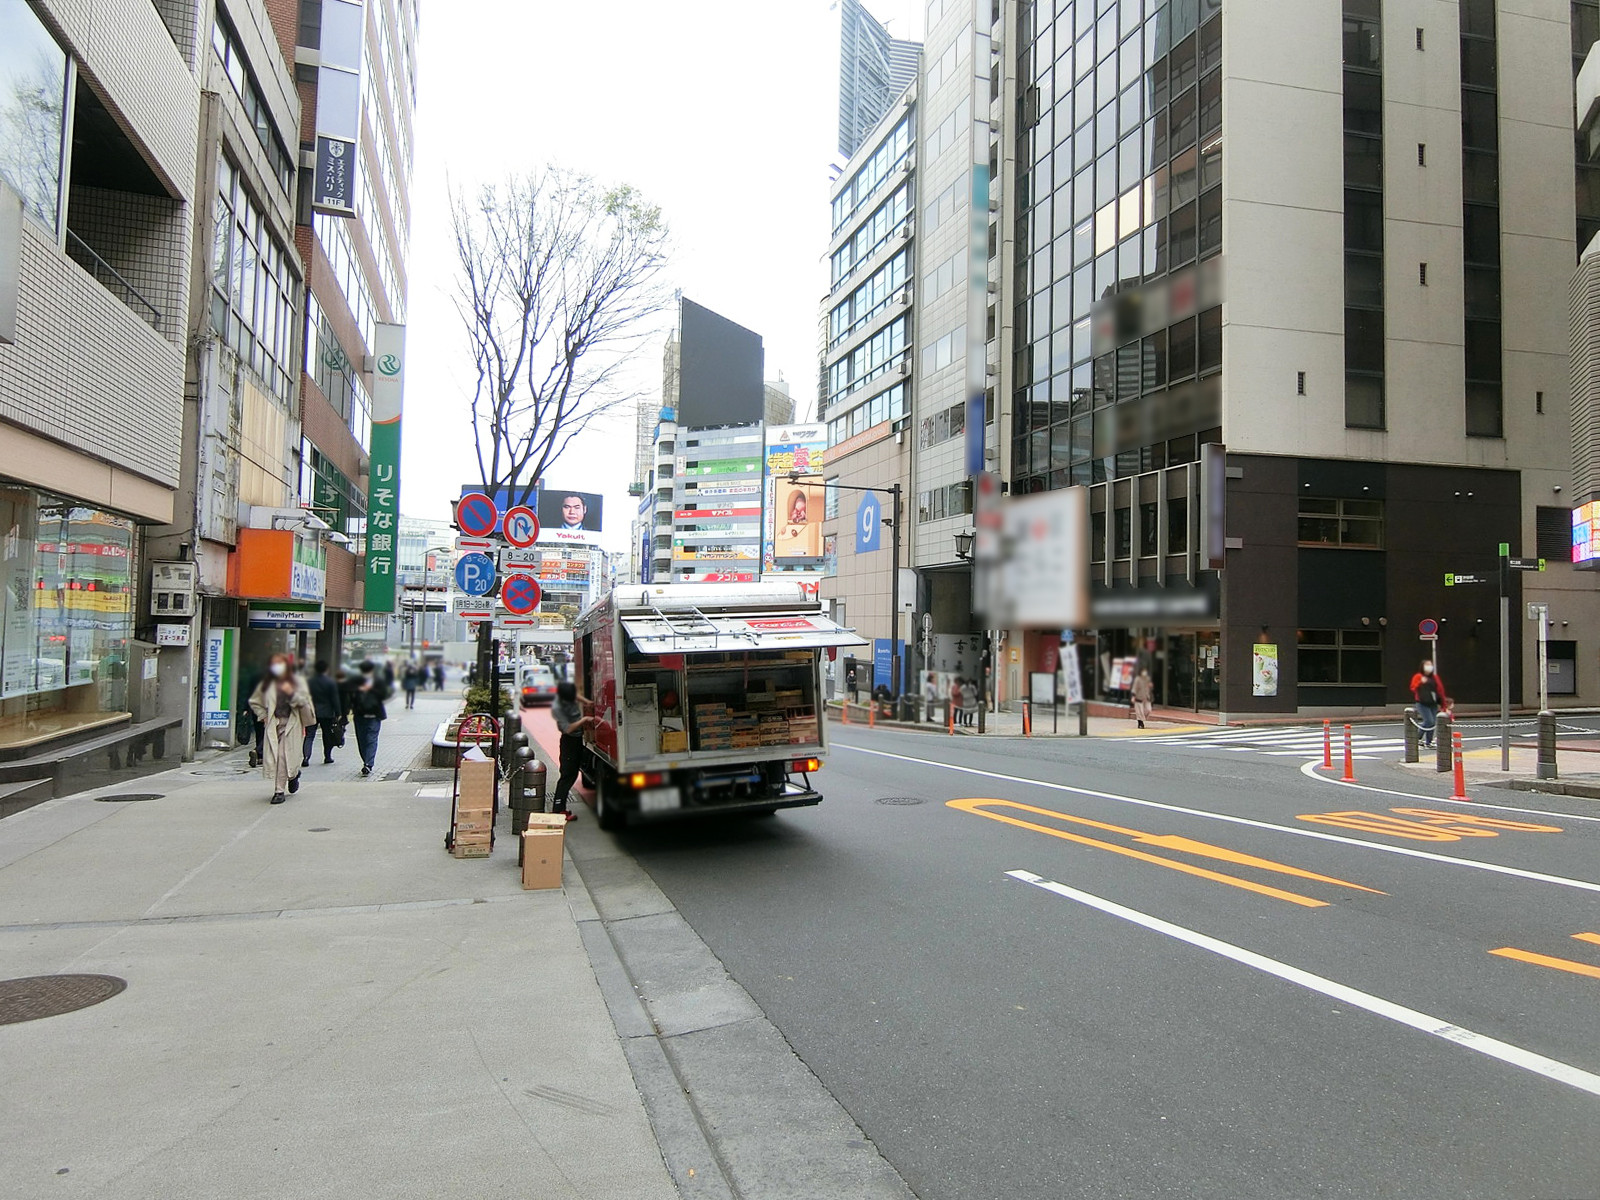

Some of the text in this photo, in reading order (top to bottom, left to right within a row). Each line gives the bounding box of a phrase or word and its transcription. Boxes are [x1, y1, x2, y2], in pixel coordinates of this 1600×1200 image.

[325, 156, 335, 192] ミス・パリ
[371, 464, 394, 575] りそな銀行
[556, 532, 586, 541] Yakult
[464, 563, 481, 591] P
[475, 579, 487, 592] 20
[267, 611, 304, 619] FamilyMart
[207, 638, 222, 700] FamilyMart
